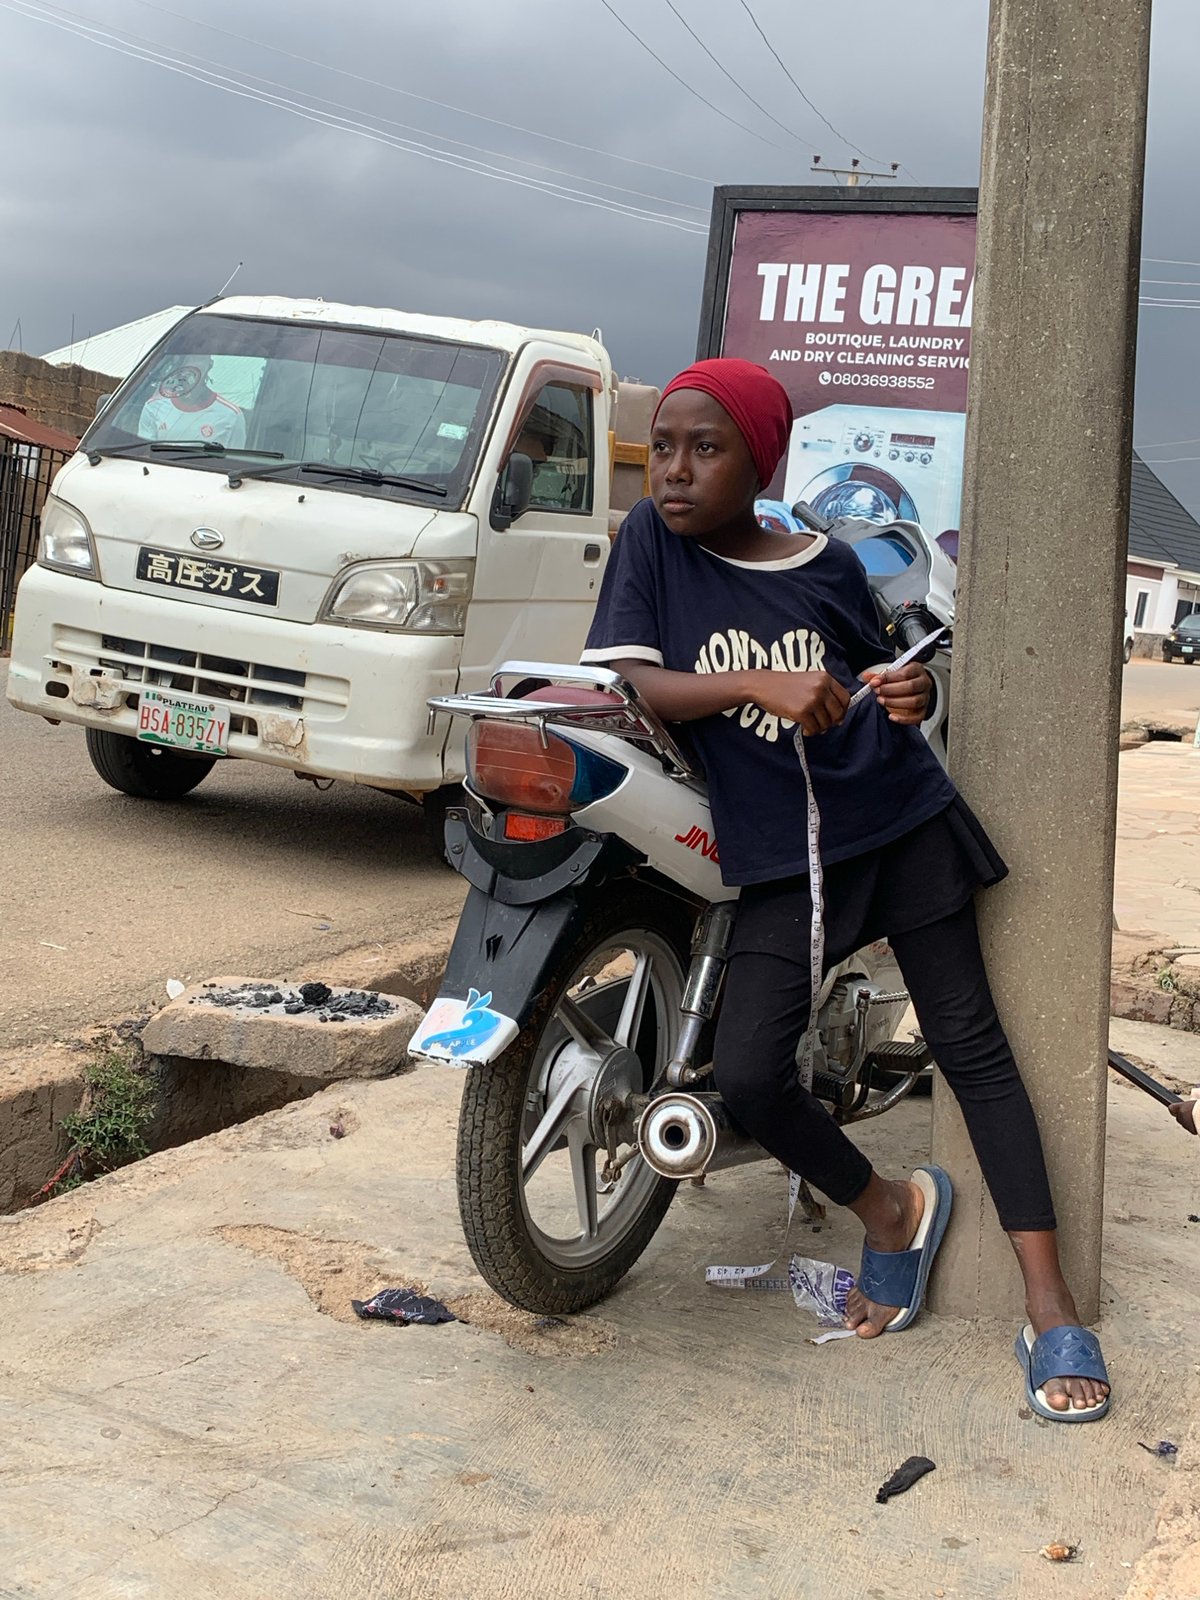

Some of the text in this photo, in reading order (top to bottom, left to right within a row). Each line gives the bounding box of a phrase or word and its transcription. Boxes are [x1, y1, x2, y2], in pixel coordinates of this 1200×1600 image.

[757, 262, 851, 323] THE
[805, 332, 965, 350] BOUTIQUE, LAUNDRY
[769, 349, 802, 361] AND
[804, 350, 835, 363] DRY
[837, 352, 915, 366] CLEANING
[832, 372, 935, 389] 08036938552
[146, 553, 265, 597] 高圧ガス
[694, 628, 827, 675] MONTAUK
[162, 697, 208, 713] PLATEAU
[140, 705, 225, 746] BSA-835ZY
